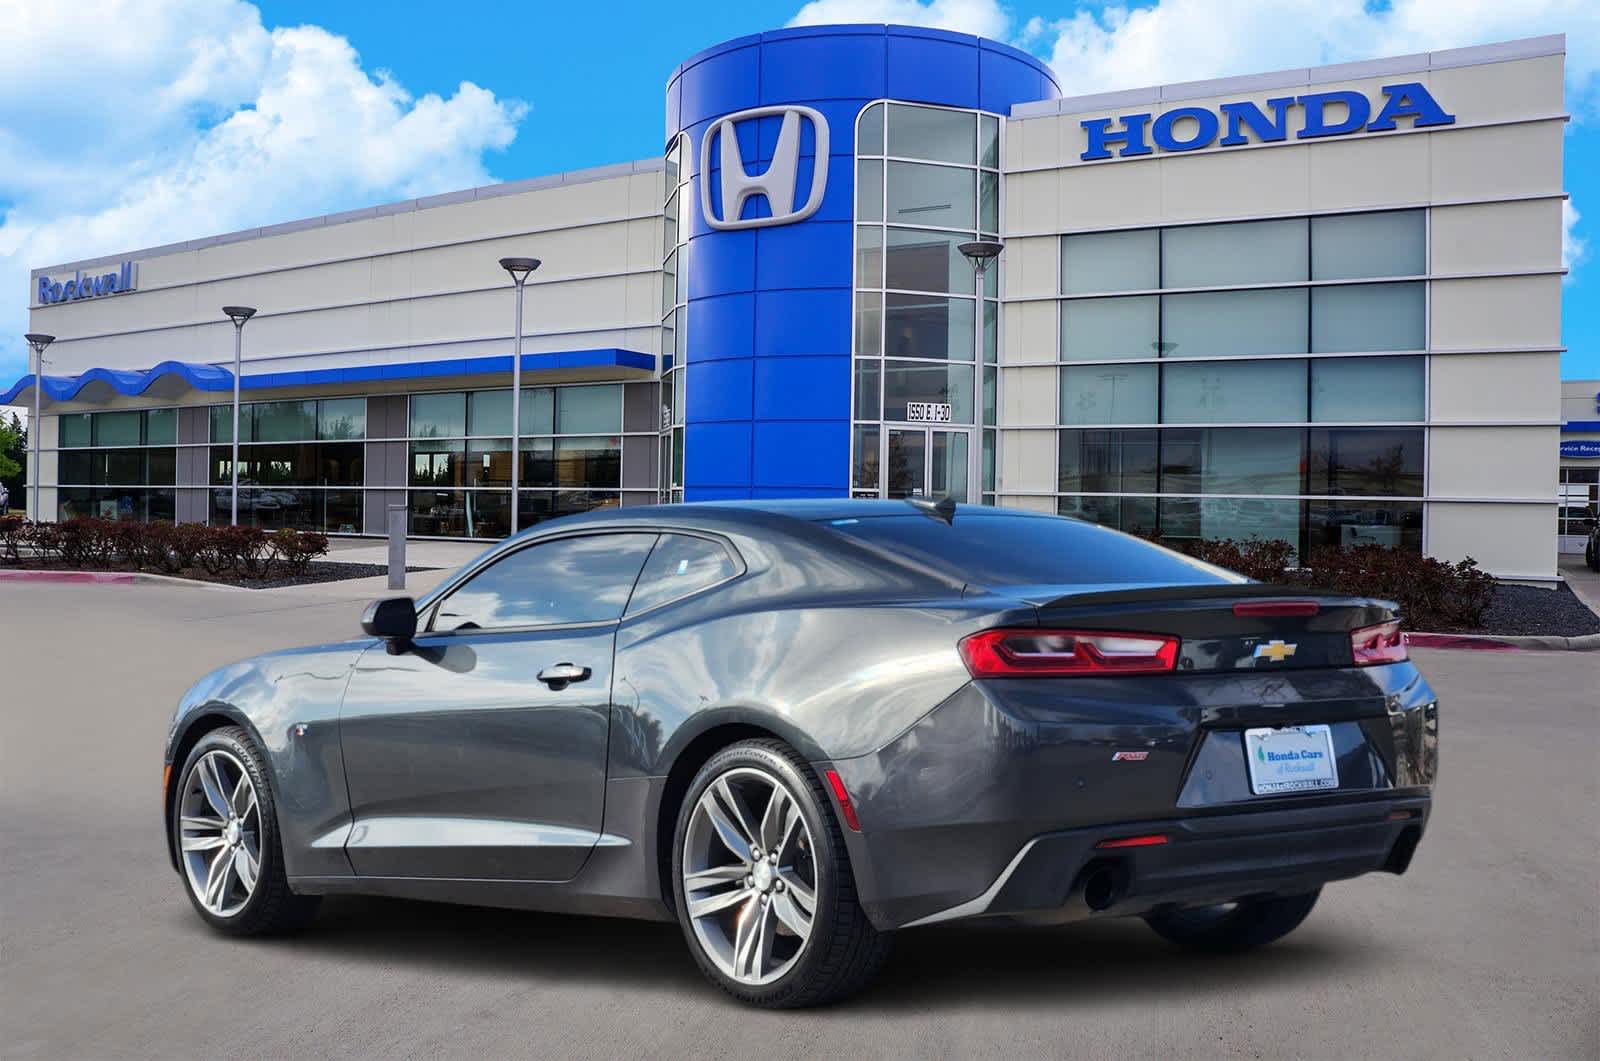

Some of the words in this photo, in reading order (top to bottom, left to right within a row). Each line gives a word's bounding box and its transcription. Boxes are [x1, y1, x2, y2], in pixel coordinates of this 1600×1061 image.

[1080, 82, 1456, 161] HONDA
[39, 261, 132, 304] Rockwall
[908, 403, 925, 420] 1550
[934, 404, 950, 421] I-30
[1267, 751, 1299, 761] Honda
[1301, 750, 1323, 759] Cars
